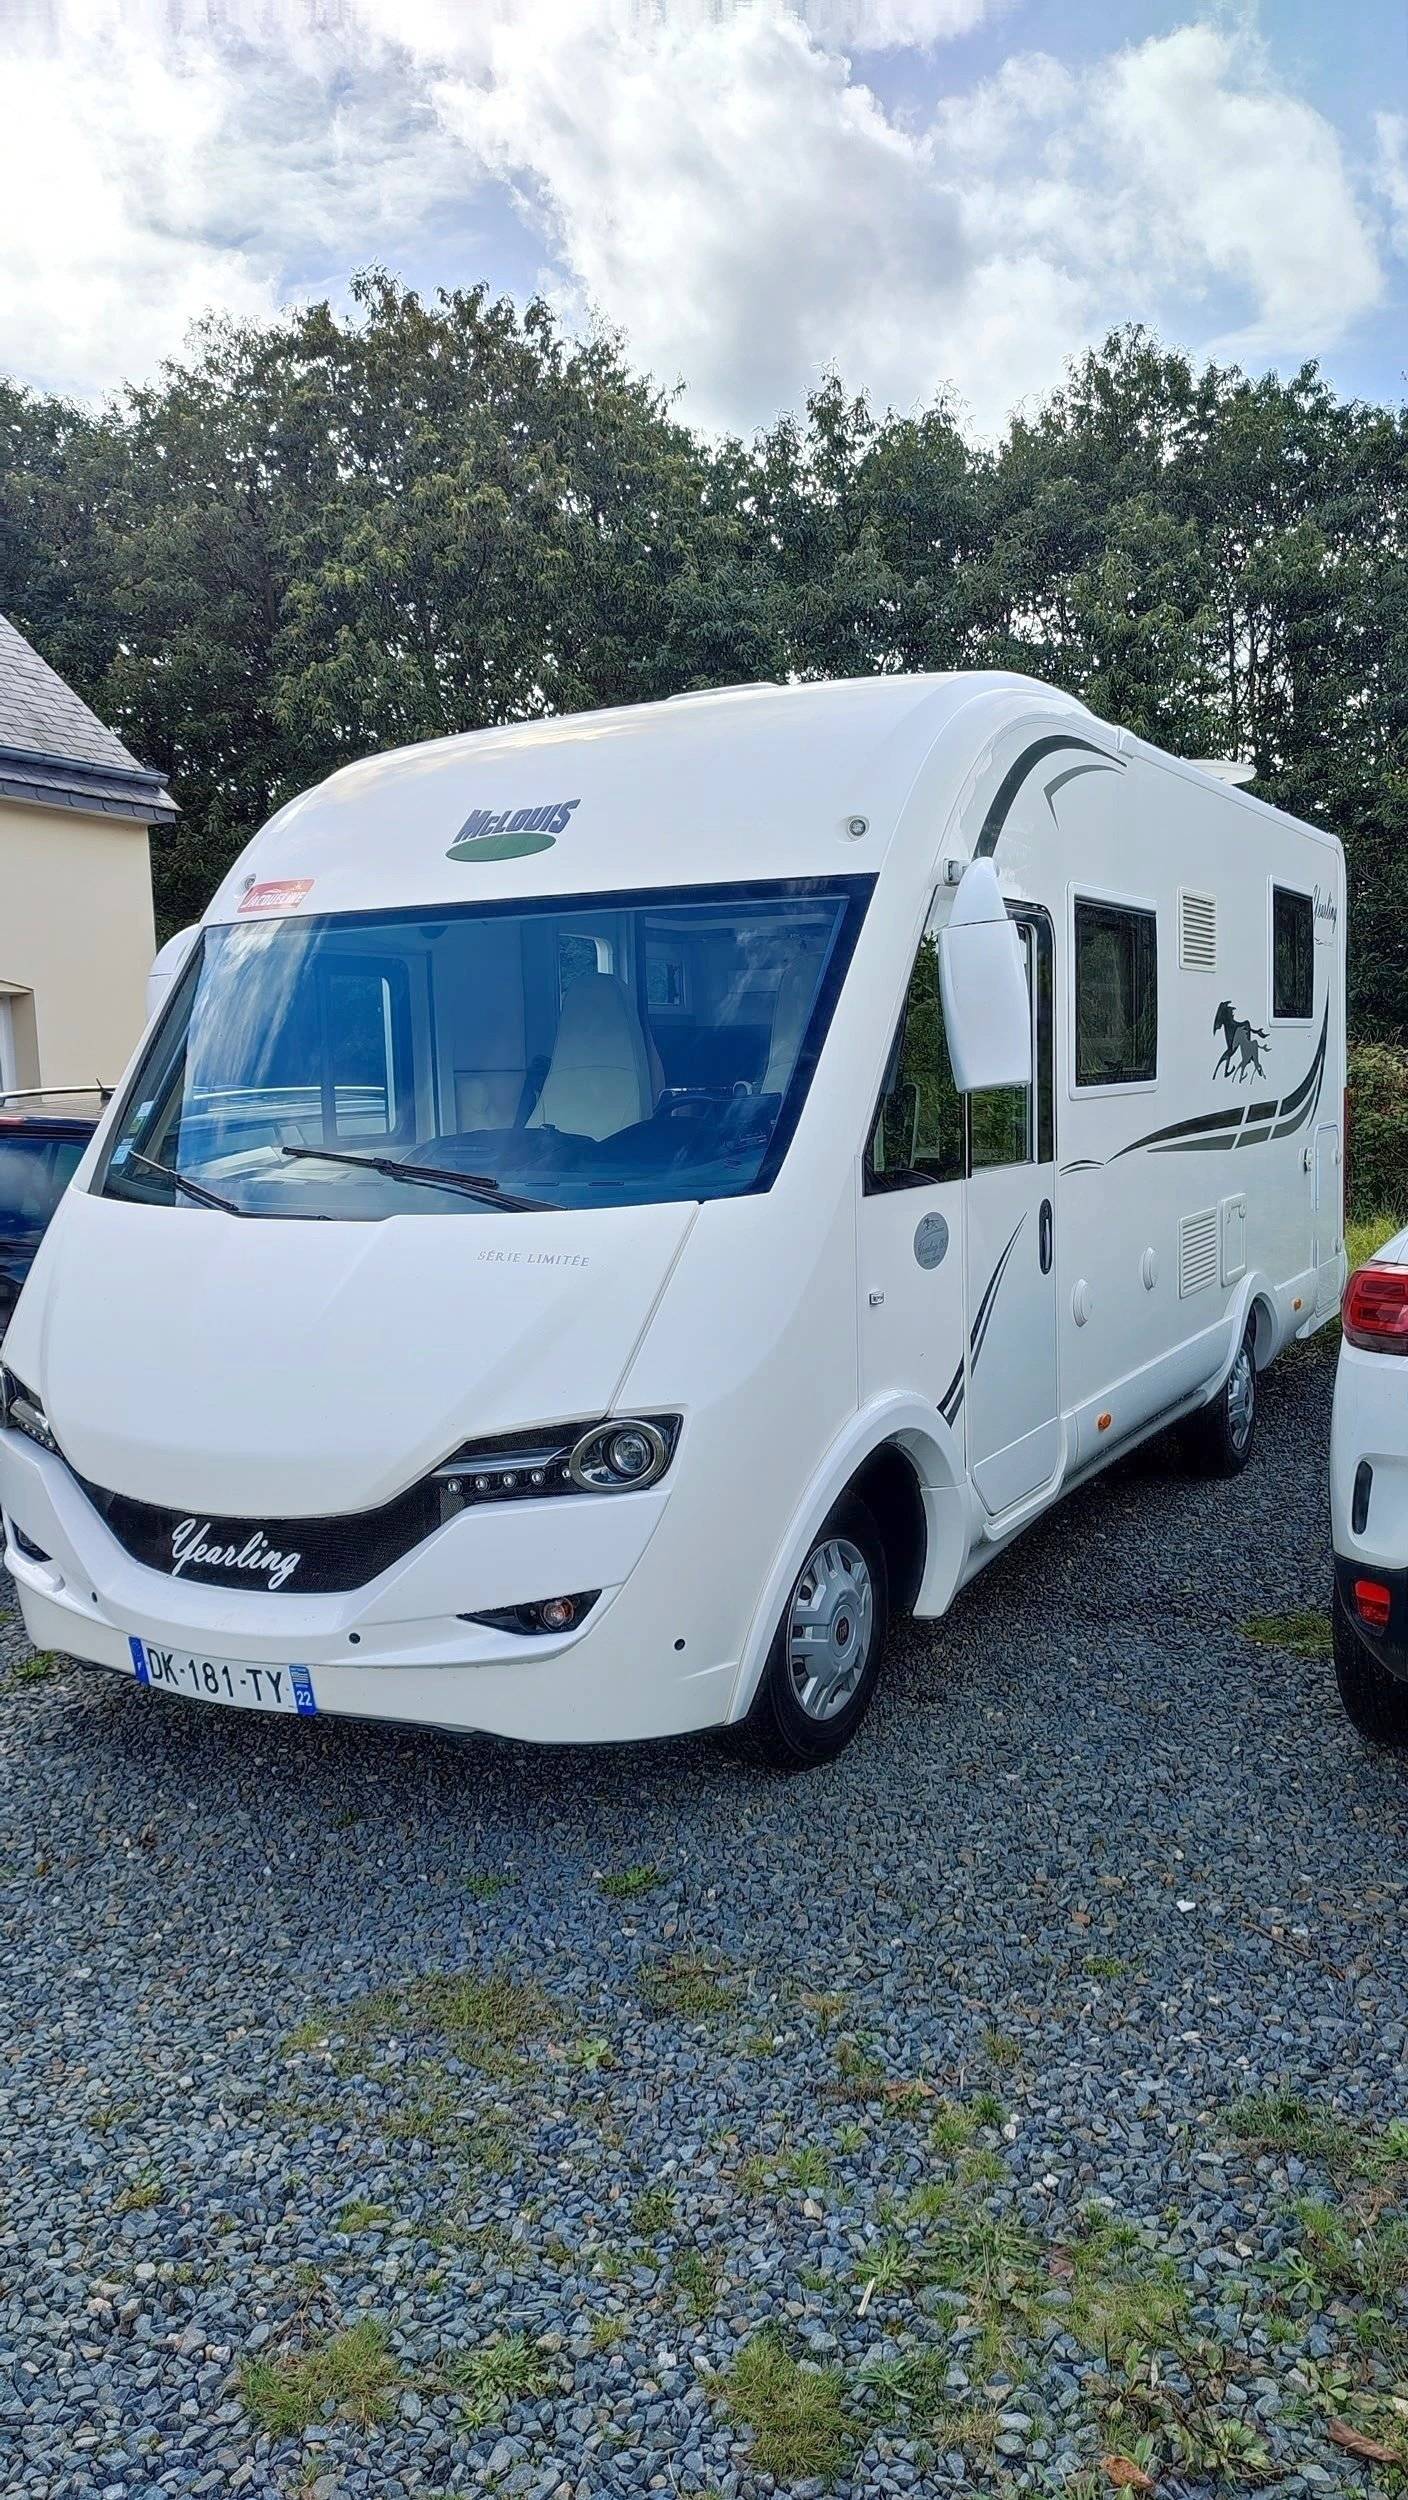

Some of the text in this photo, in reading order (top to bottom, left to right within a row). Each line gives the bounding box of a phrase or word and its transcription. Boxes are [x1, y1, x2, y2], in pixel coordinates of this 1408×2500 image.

[477, 1250, 590, 1267] SÉRIE LIMITÉE
[171, 1518, 301, 1590] Yearling
[146, 1648, 282, 1703] DK-181-TY
[296, 1690, 313, 1706] 22
